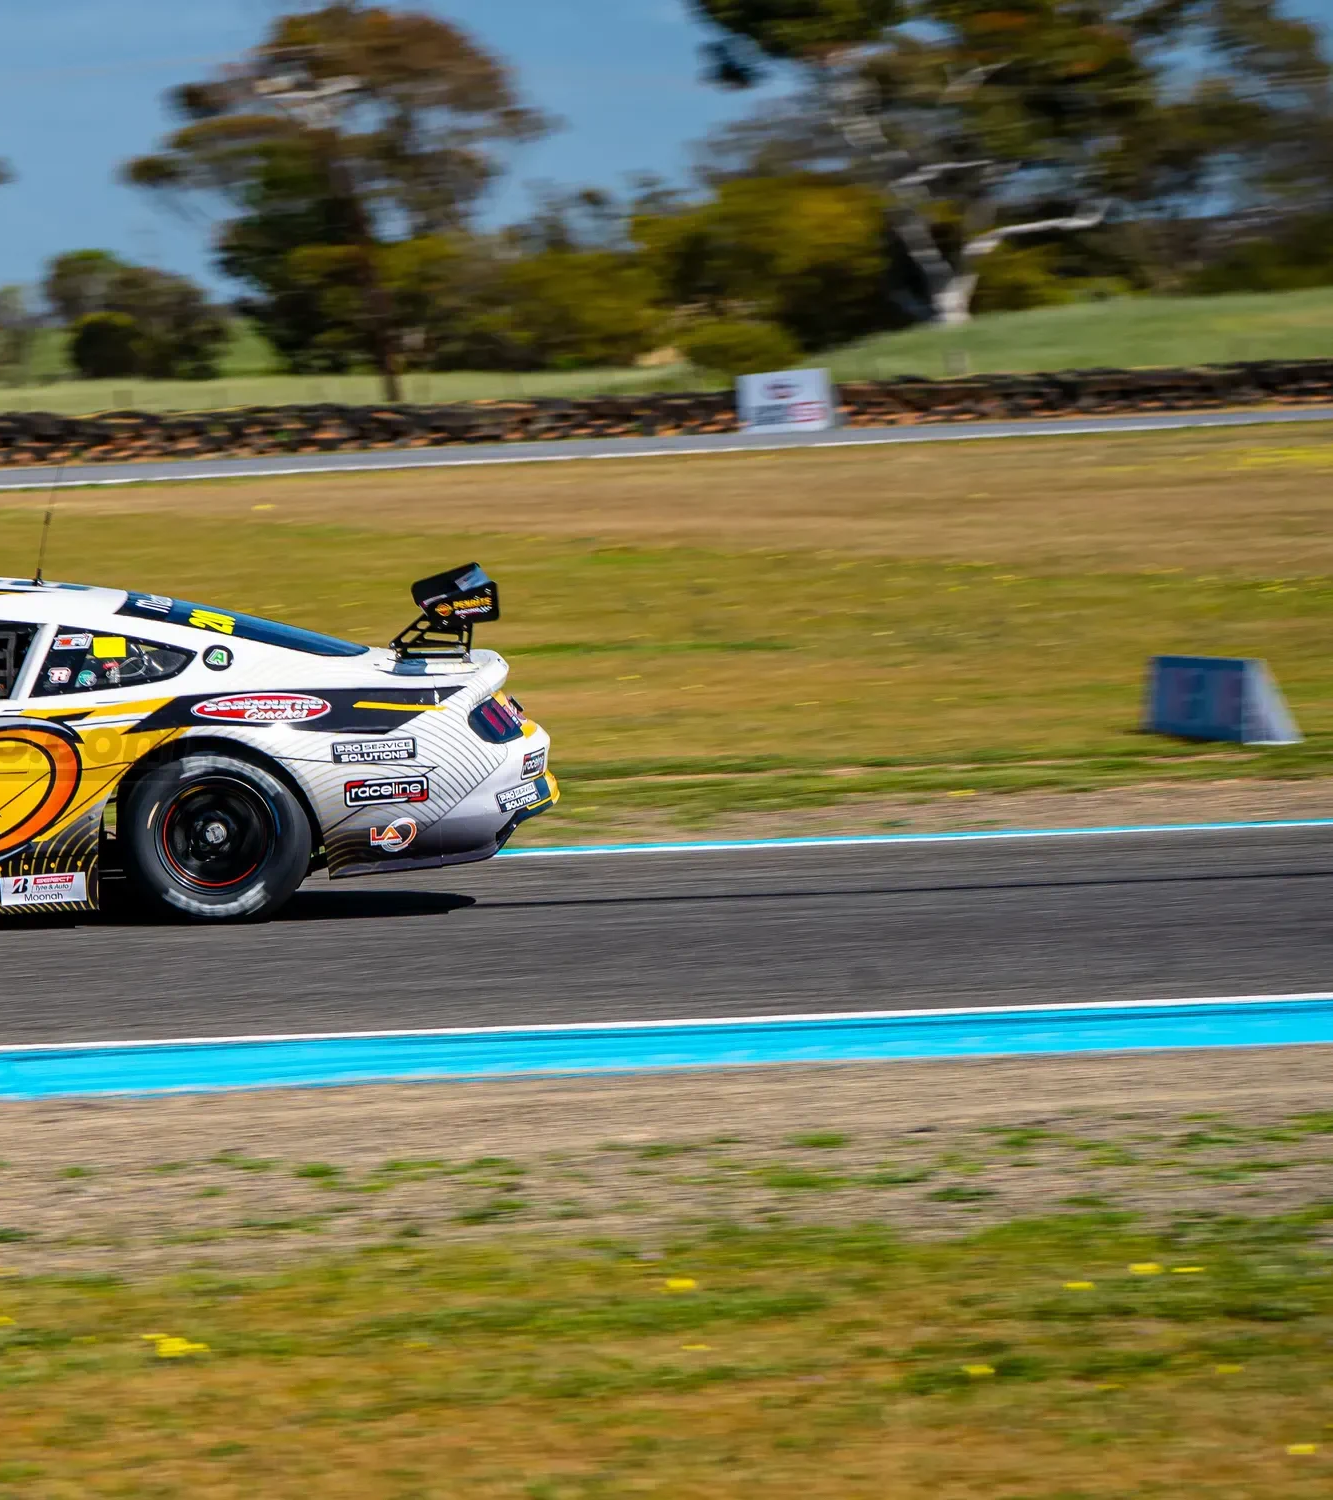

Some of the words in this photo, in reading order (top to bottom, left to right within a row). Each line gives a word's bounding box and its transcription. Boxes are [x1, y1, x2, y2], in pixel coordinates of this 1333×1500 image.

[336, 744, 361, 753] PRO
[363, 741, 411, 751] SERVICE
[341, 750, 408, 762] SOLUTIONS
[351, 783, 421, 798] raceline
[24, 892, 63, 901] Moonah
